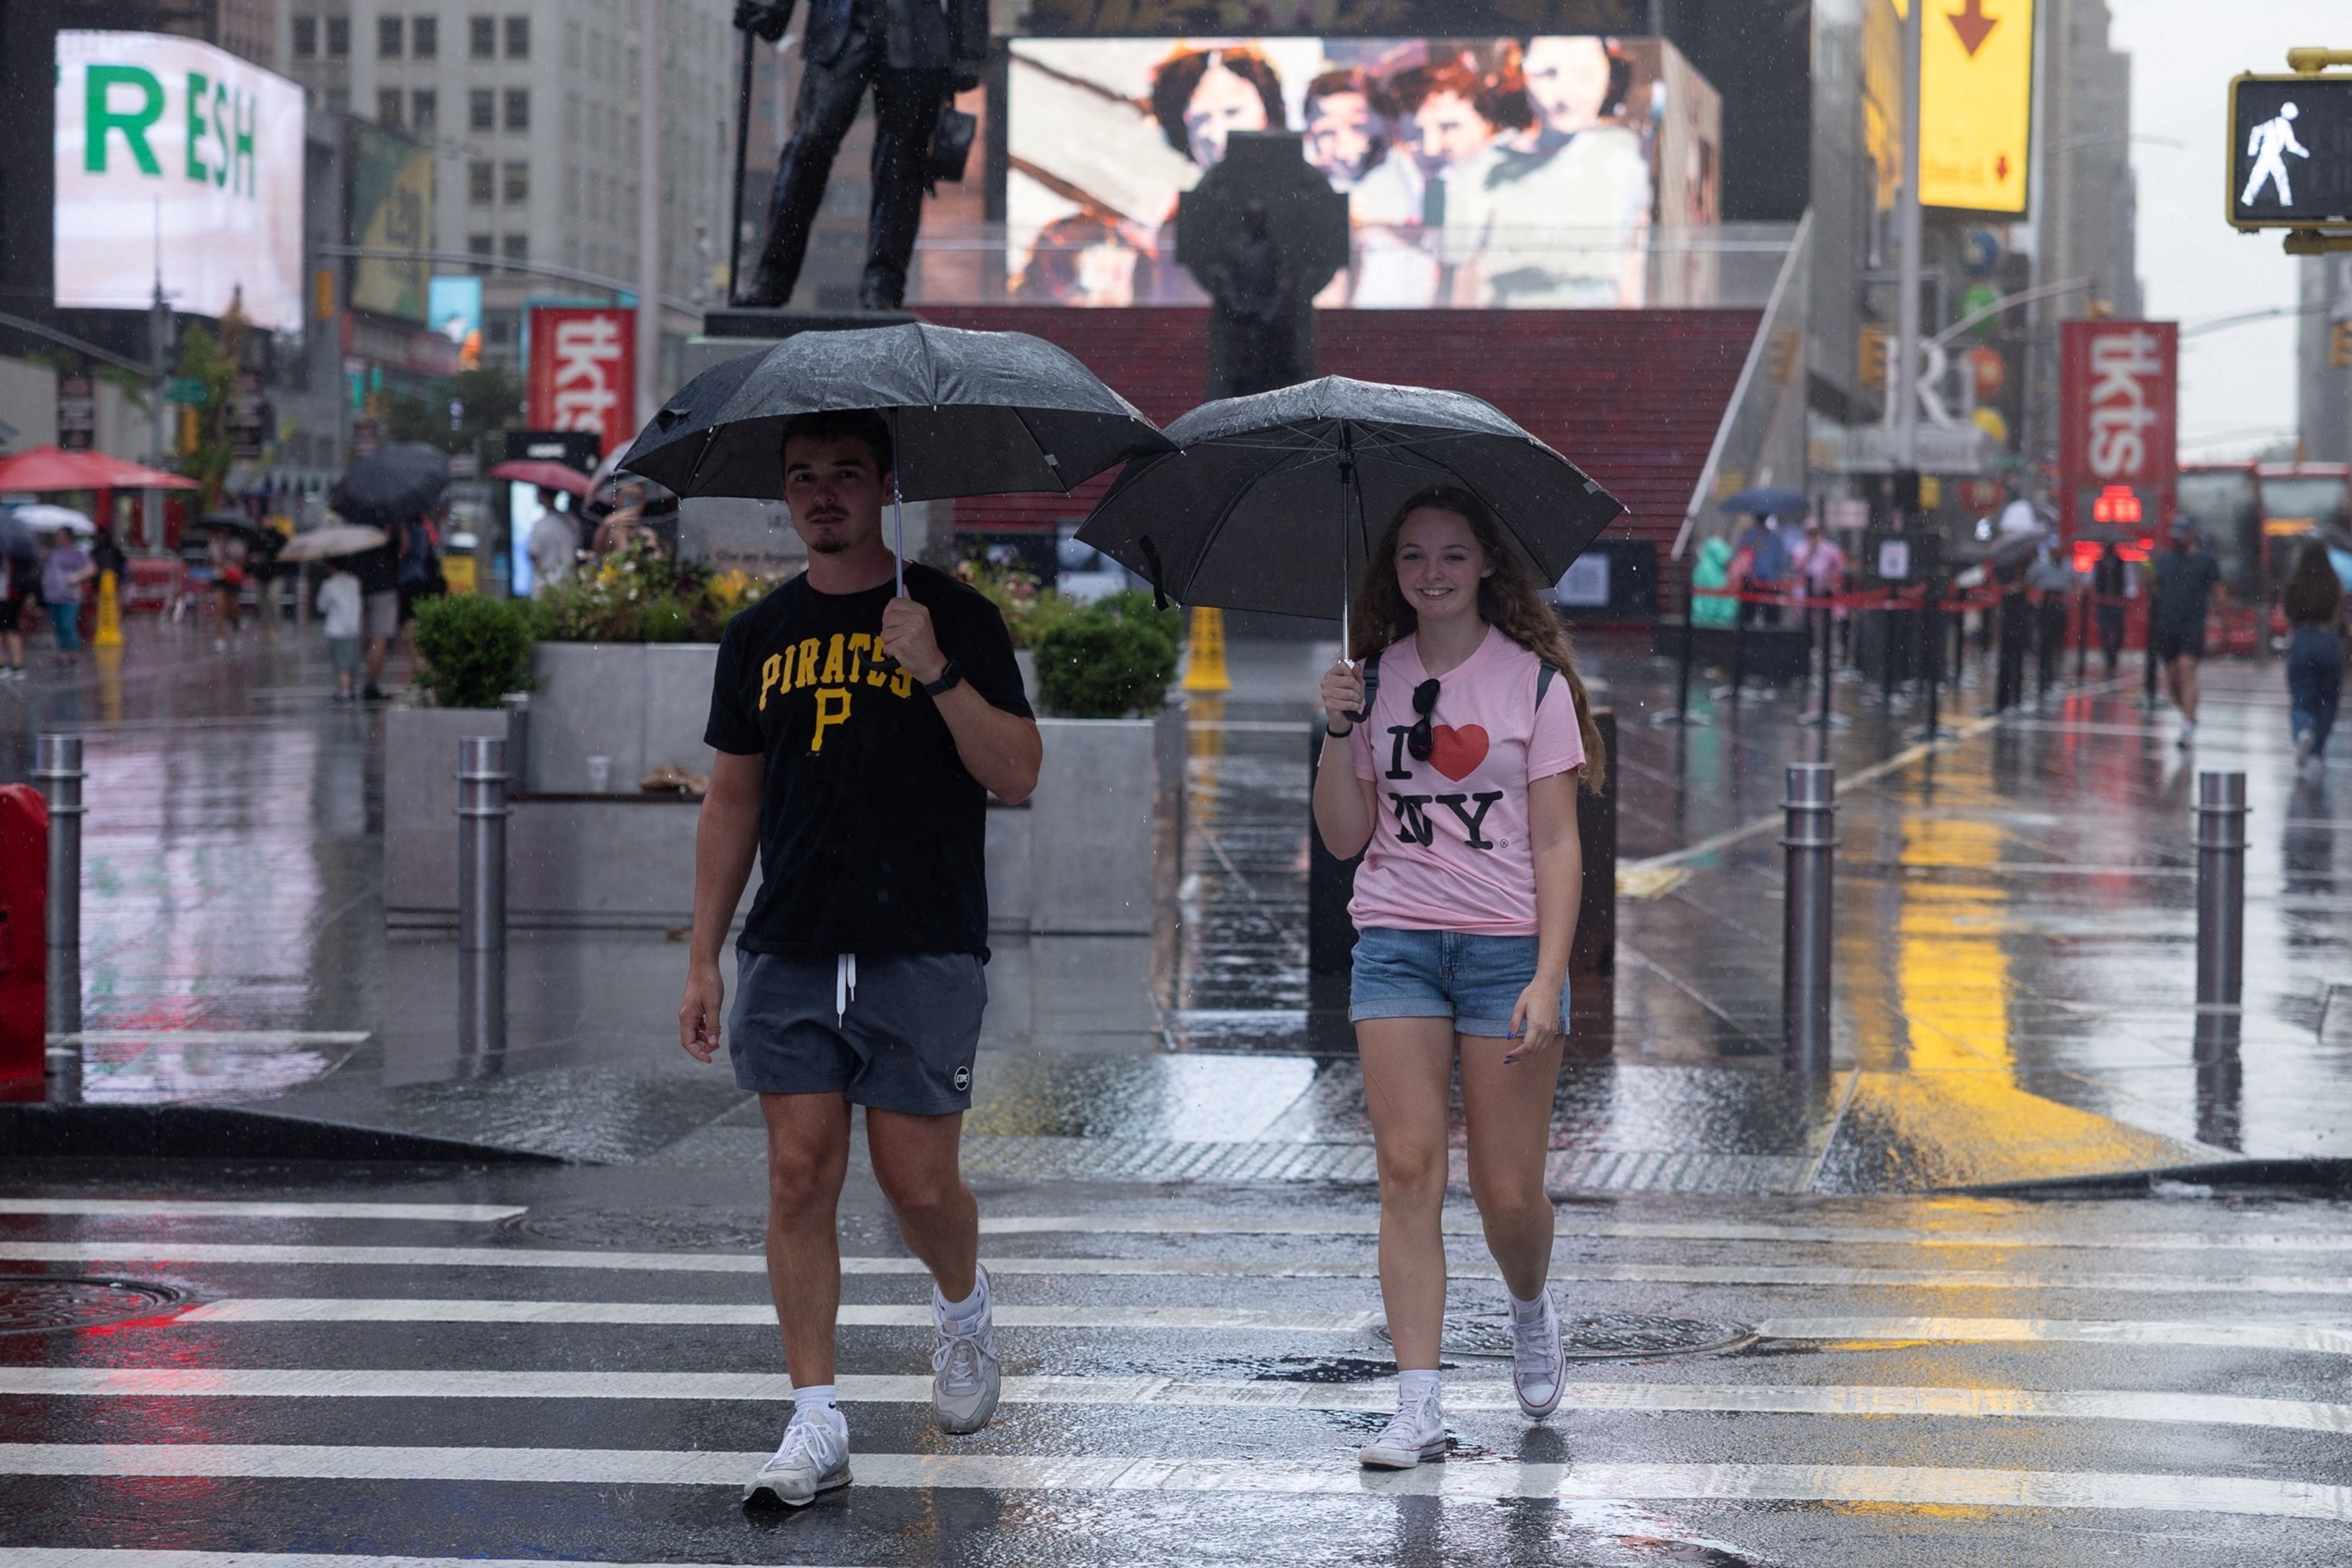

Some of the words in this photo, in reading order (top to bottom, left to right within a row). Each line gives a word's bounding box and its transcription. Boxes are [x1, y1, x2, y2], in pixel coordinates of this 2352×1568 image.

[55, 64, 256, 198] RESH
[2089, 328, 2162, 478] tkts
[759, 633, 912, 710] PIRATES
[811, 687, 852, 752] P
[1385, 725, 1414, 780] I
[1387, 791, 1503, 850] NY
